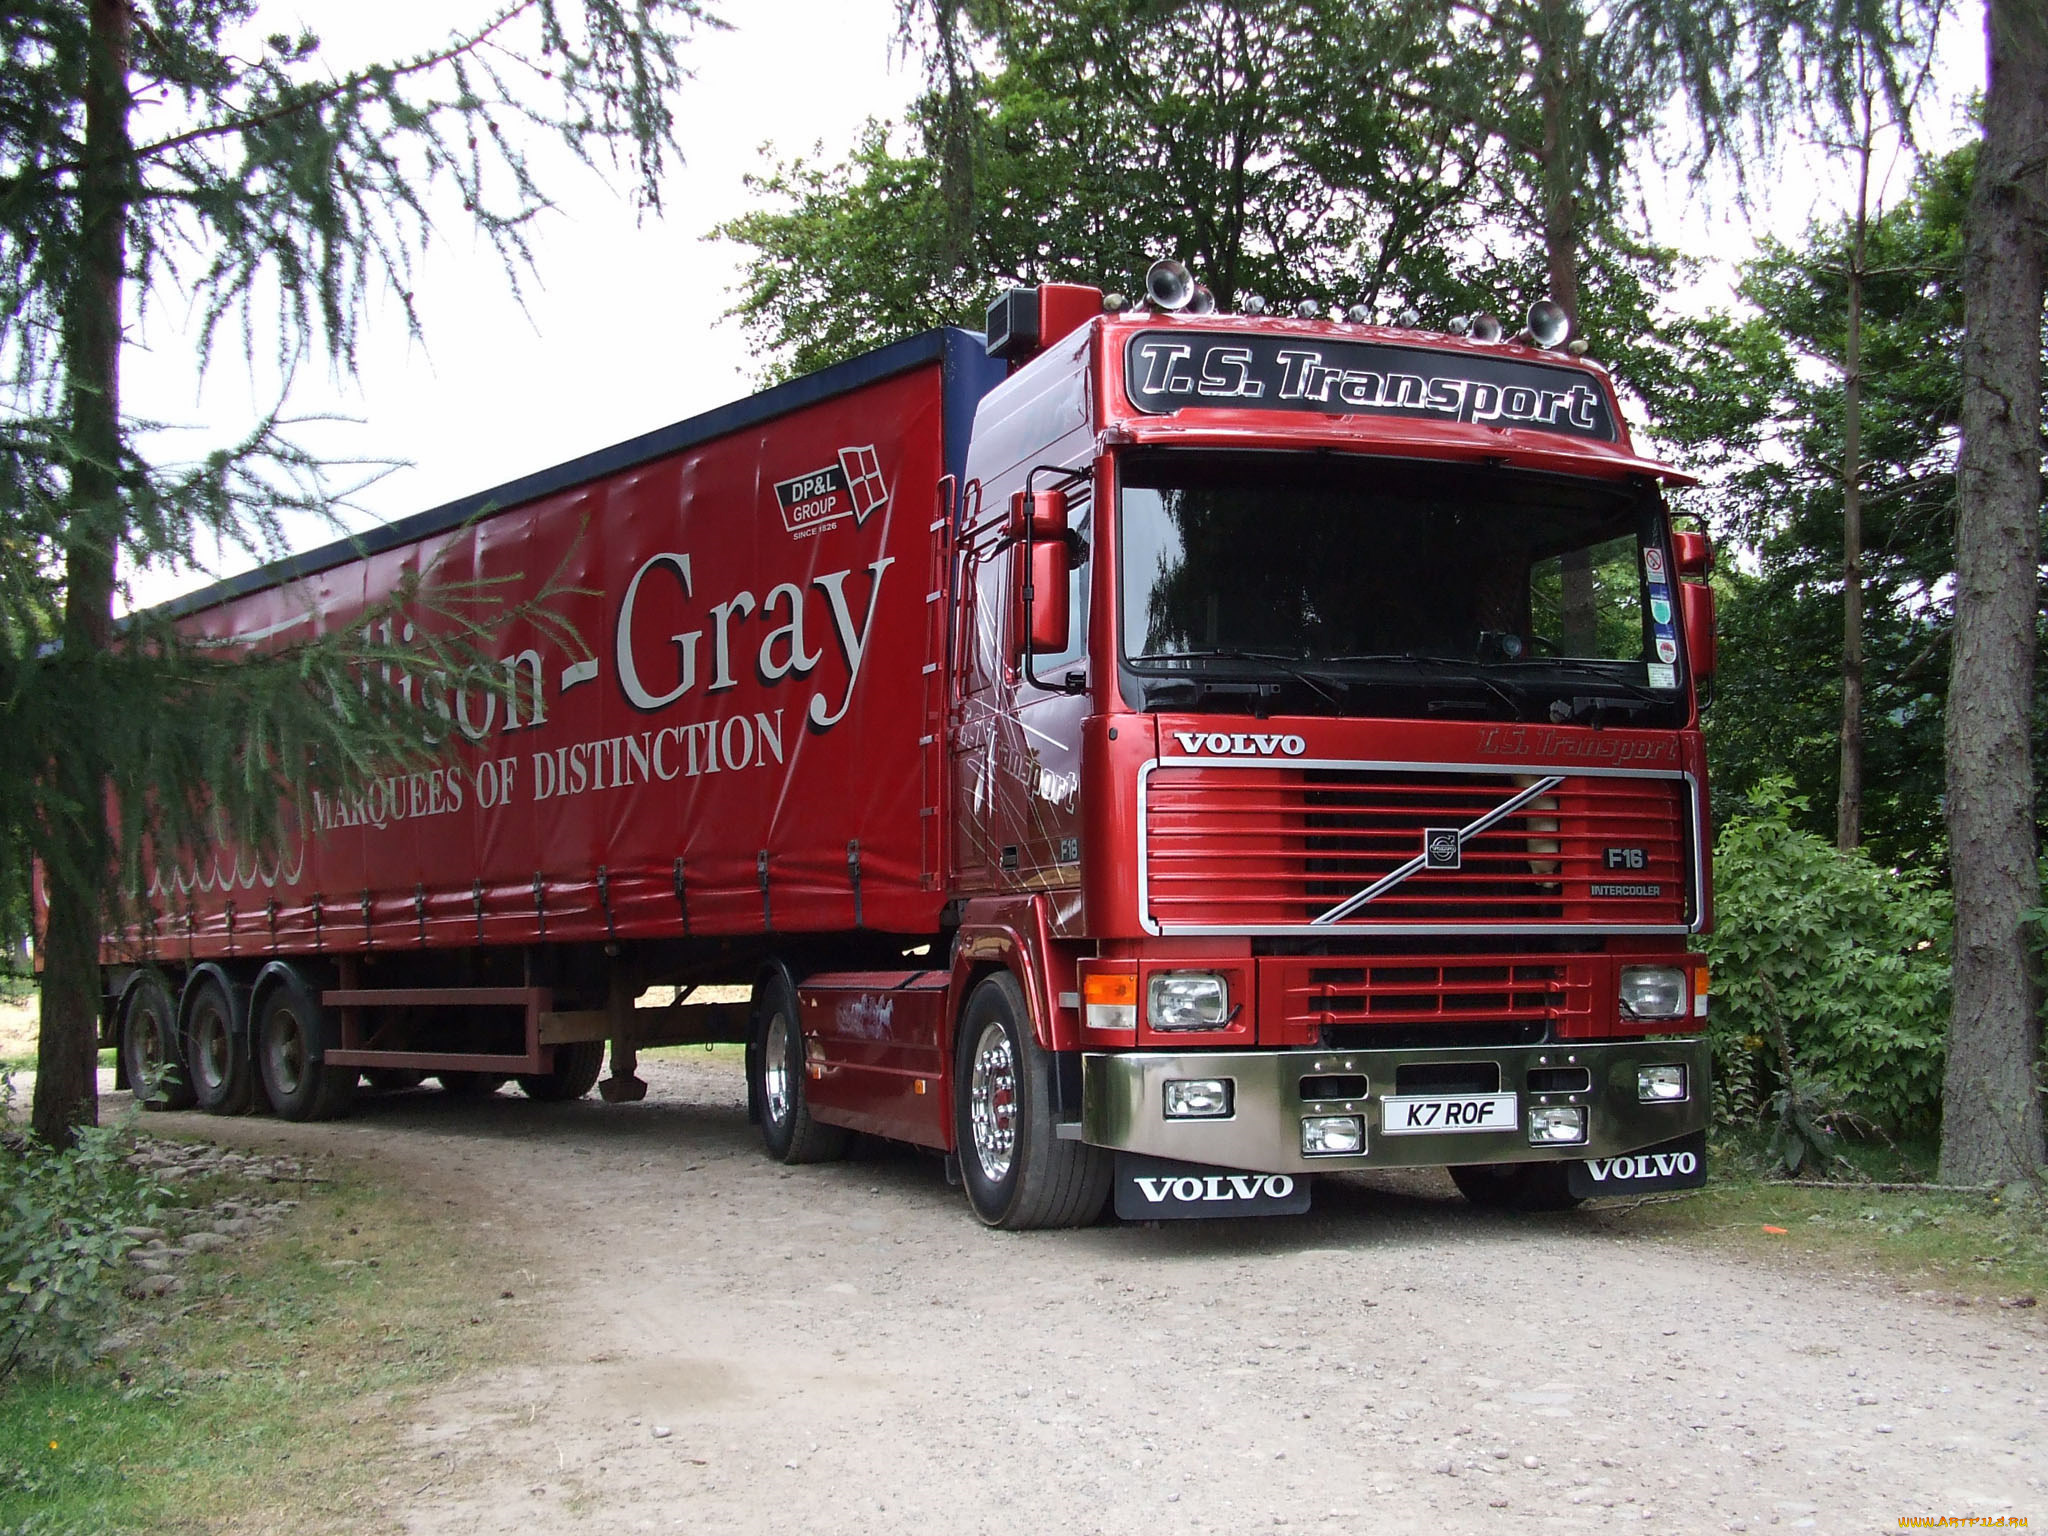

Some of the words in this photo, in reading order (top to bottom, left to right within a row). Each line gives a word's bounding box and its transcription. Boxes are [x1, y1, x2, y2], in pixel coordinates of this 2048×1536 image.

[1141, 343, 1265, 398] T.S.
[1276, 350, 1598, 429] Transport
[792, 473, 837, 503] DP&L
[793, 496, 836, 522] GROUP
[793, 527, 817, 541] SINCE
[818, 522, 838, 534] 1826
[322, 552, 895, 744] llison-Gray
[1173, 732, 1306, 755] VOLVO
[1479, 727, 1528, 755] T.S.
[1536, 731, 1680, 766] Transport
[312, 767, 463, 830] MARQUEES
[476, 757, 517, 809] OF
[533, 709, 785, 801] DISTINCTION
[1608, 848, 1644, 869] F16
[1591, 885, 1660, 897] INTERCOOLER
[1407, 1103, 1441, 1127] K7
[1445, 1101, 1495, 1125] ROF
[1583, 1151, 1697, 1181] VOLVO
[1133, 1175, 1294, 1202] VOLVO
